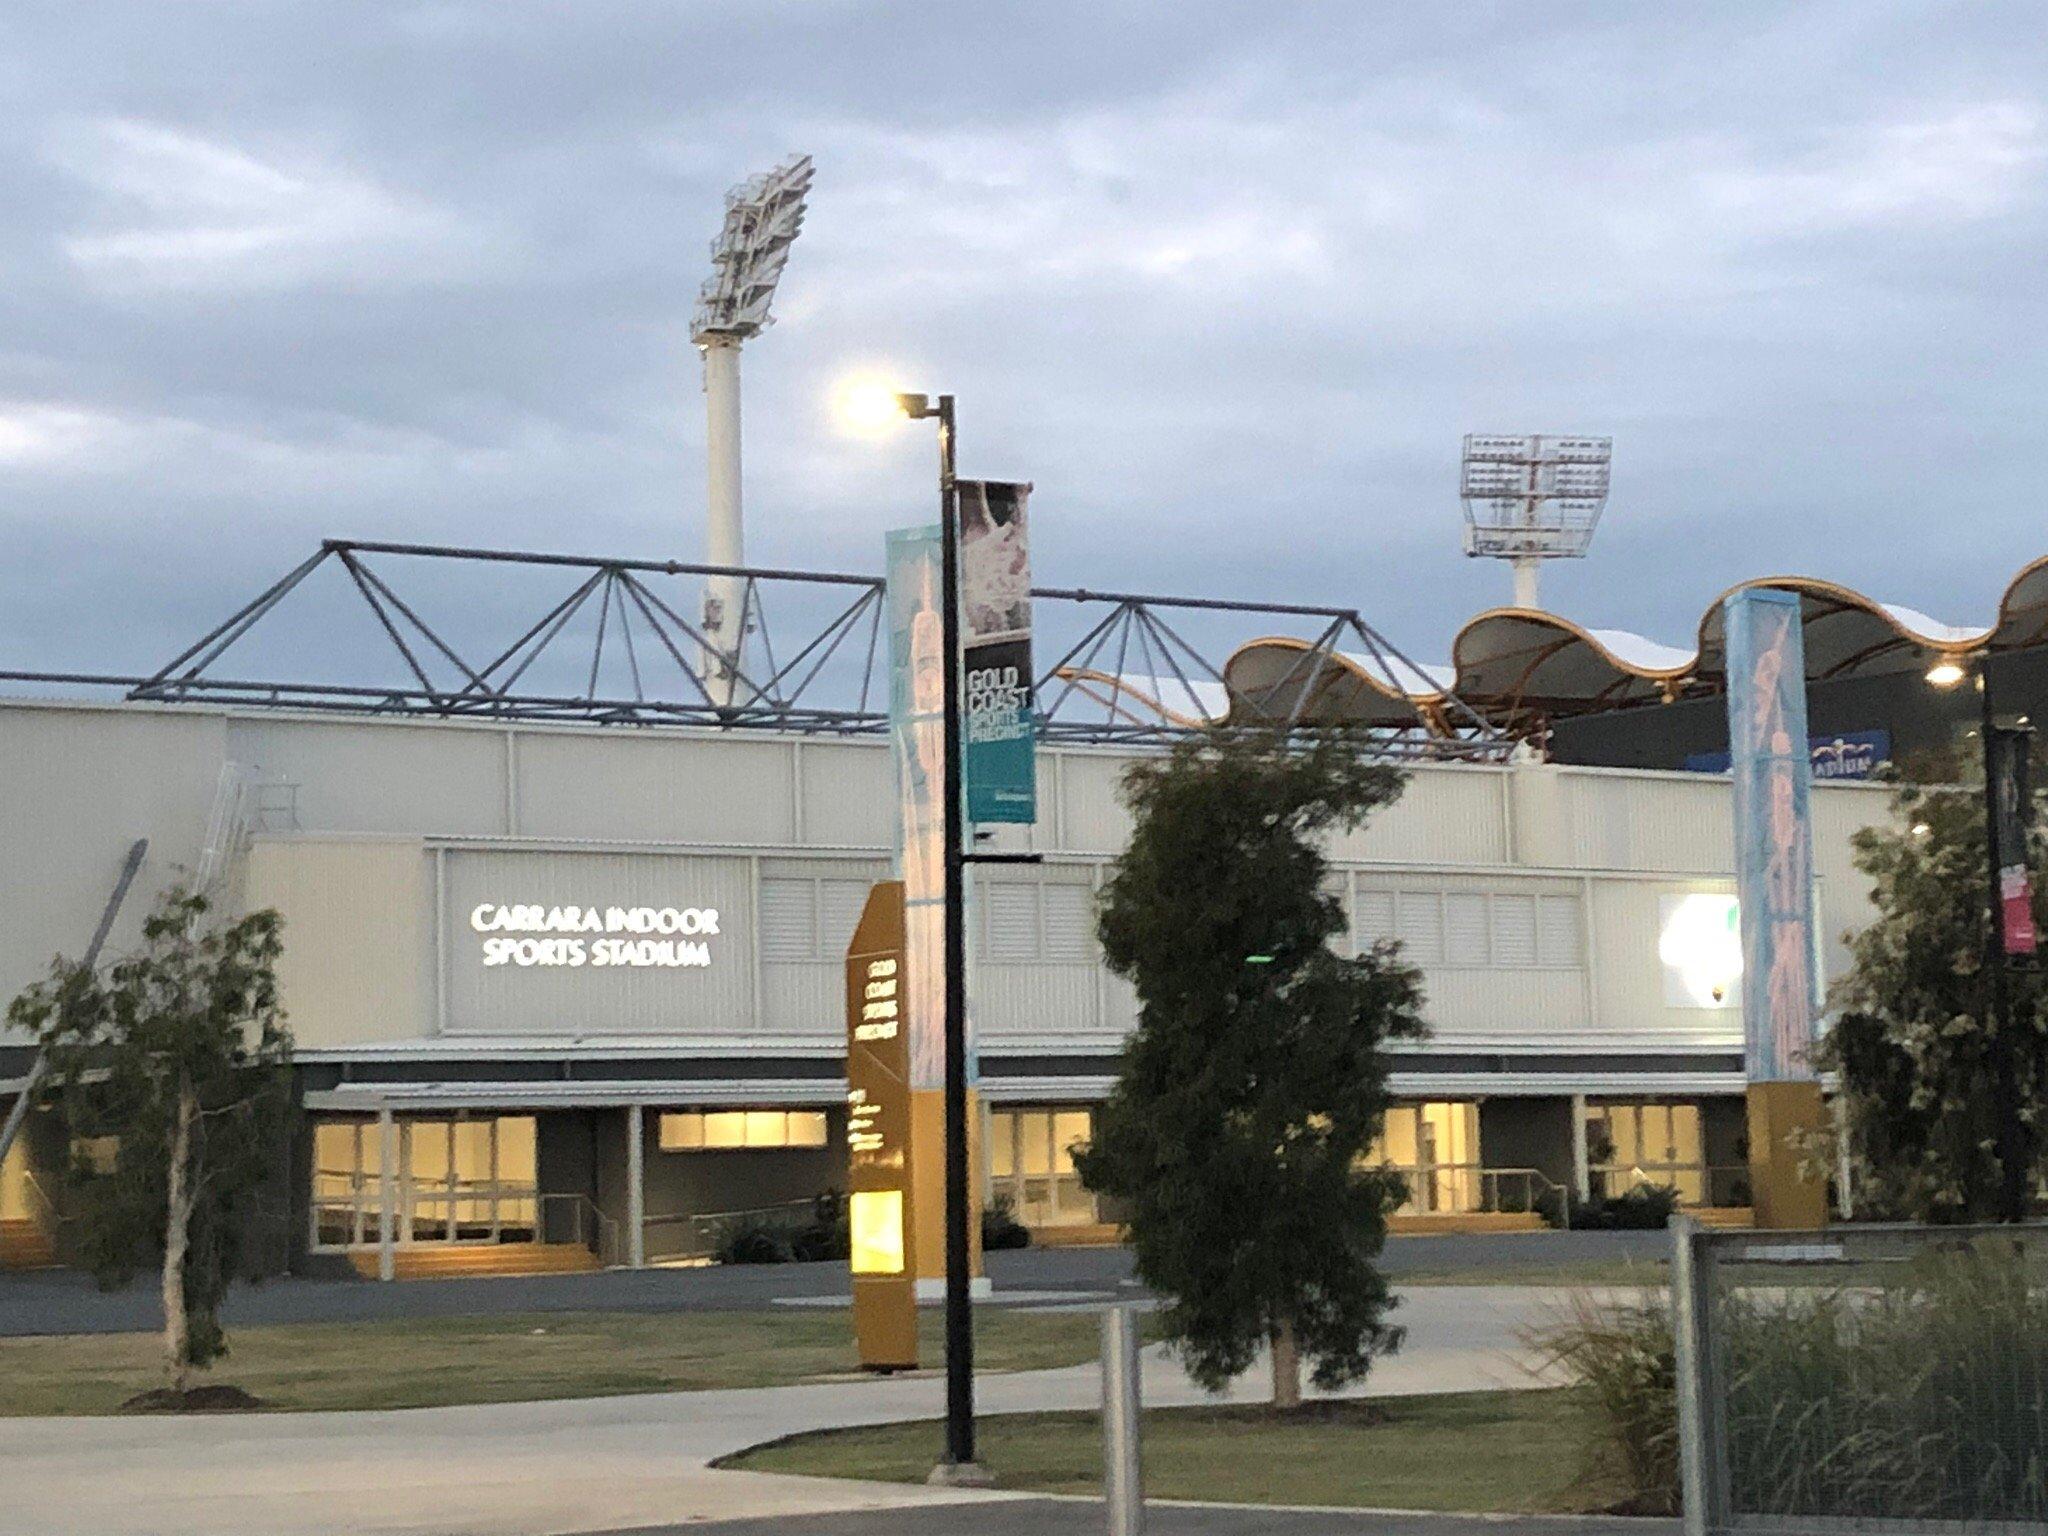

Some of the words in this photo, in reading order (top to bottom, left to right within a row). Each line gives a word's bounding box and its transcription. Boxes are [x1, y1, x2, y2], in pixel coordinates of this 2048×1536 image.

[968, 667, 1018, 691] GOLD
[968, 686, 1029, 712] COAST
[471, 903, 603, 931] CARRARA
[606, 906, 720, 935] INDOOR
[483, 938, 586, 966] SPORTS
[591, 938, 711, 967] STADIUM
